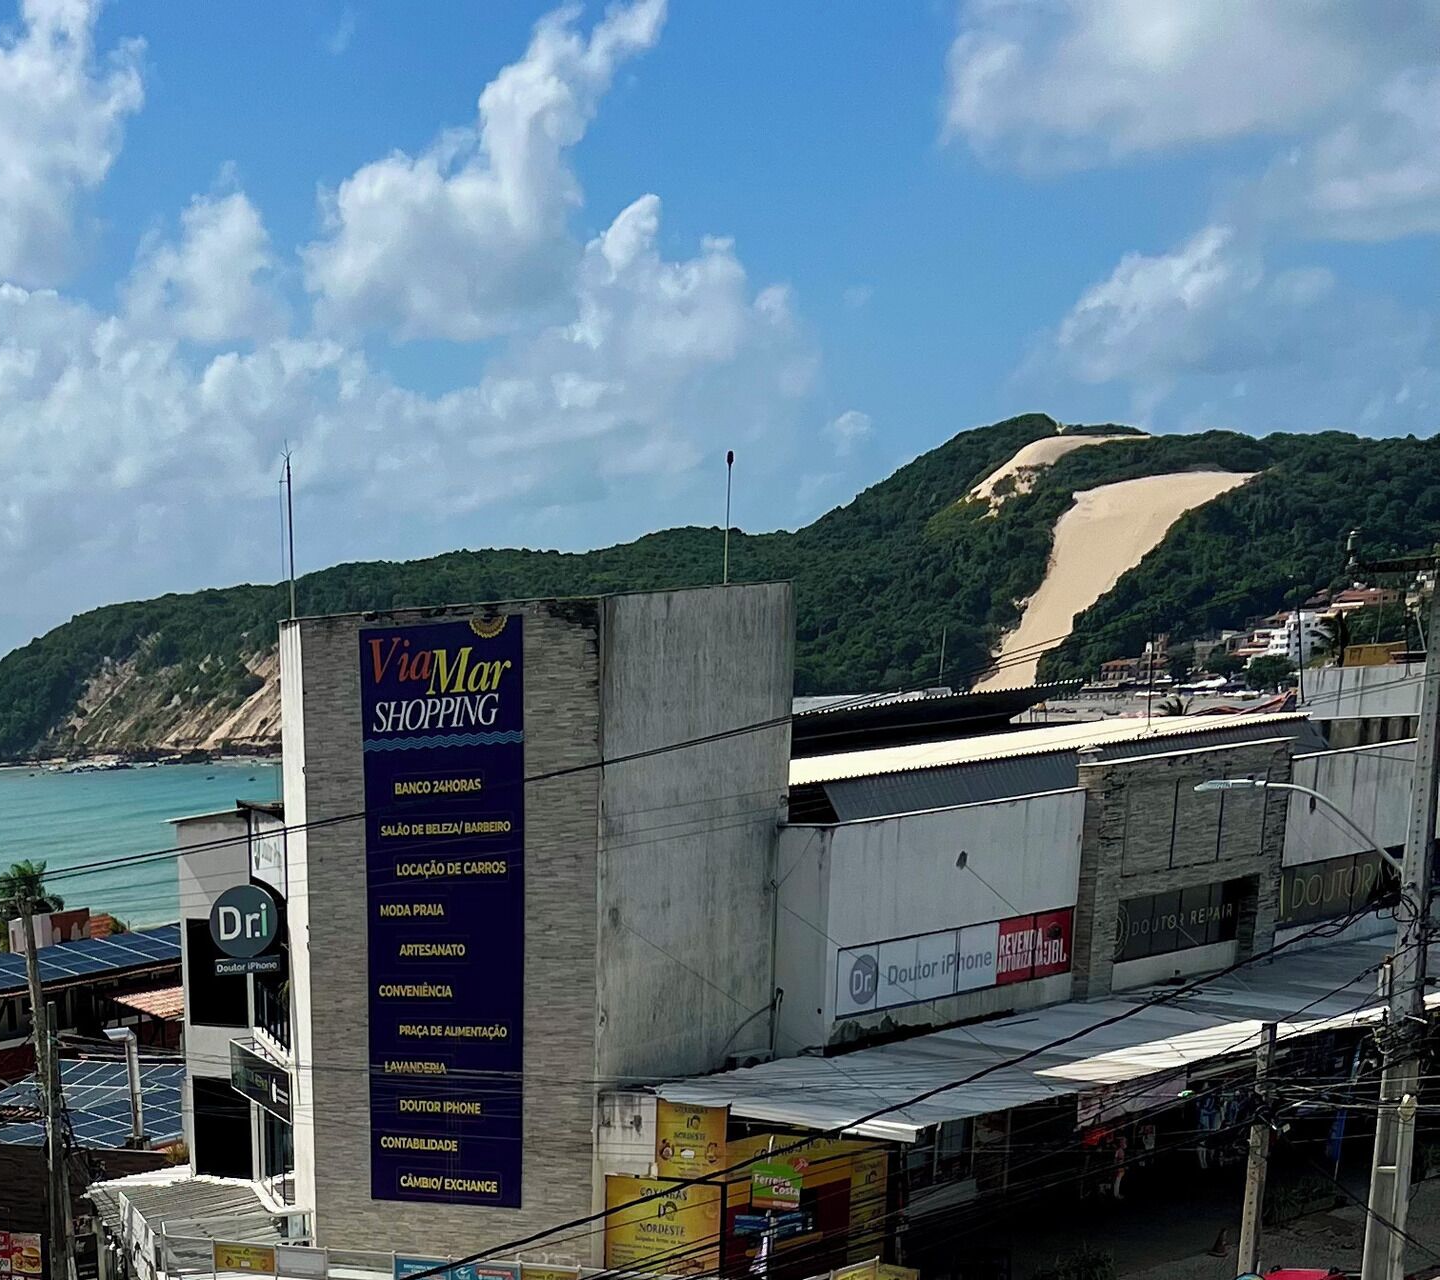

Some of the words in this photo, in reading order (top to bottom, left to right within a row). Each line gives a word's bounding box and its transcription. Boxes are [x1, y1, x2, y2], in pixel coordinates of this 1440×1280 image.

[368, 636, 511, 695] ViaMar
[373, 693, 499, 733] SHOPPING
[394, 781, 431, 795] BANCO
[432, 778, 481, 793] 24HORAS
[380, 823, 410, 836] SALÃO
[411, 823, 425, 835] DE
[425, 820, 462, 834] BELEZA/
[464, 821, 511, 833] BARBEIRO
[396, 861, 445, 879] LOCAÇÃO
[447, 862, 461, 874] DE
[463, 861, 506, 874] CARROS
[380, 904, 411, 917] MODA
[413, 903, 444, 916] PRAIA
[1131, 913, 1185, 936] DOUTOR
[1190, 903, 1233, 926] REPAIR
[999, 927, 1044, 956] REVENDA
[399, 944, 466, 956] ARTESANATO
[216, 962, 246, 973] Doutor
[247, 961, 277, 972] iPhone
[887, 960, 938, 986] Doutor
[941, 950, 992, 976] iPhone
[379, 982, 453, 997] CONVENIÊNCIA
[399, 1025, 429, 1038] PRAÇA
[430, 1026, 443, 1036] DE
[444, 1024, 507, 1039] ALIMENTAÇÃO
[384, 1061, 447, 1074] LAVANDERIA
[399, 1100, 441, 1113] DOUTOR
[443, 1102, 481, 1114] IPHONE
[380, 1136, 458, 1152] CONTABILIDADE
[400, 1176, 443, 1190] CÂMBIO/
[444, 1179, 498, 1193] EXCHANGE
[754, 1174, 791, 1187] Ferreira
[772, 1185, 799, 1196] Costa
[639, 1223, 686, 1237] NORDESTE
